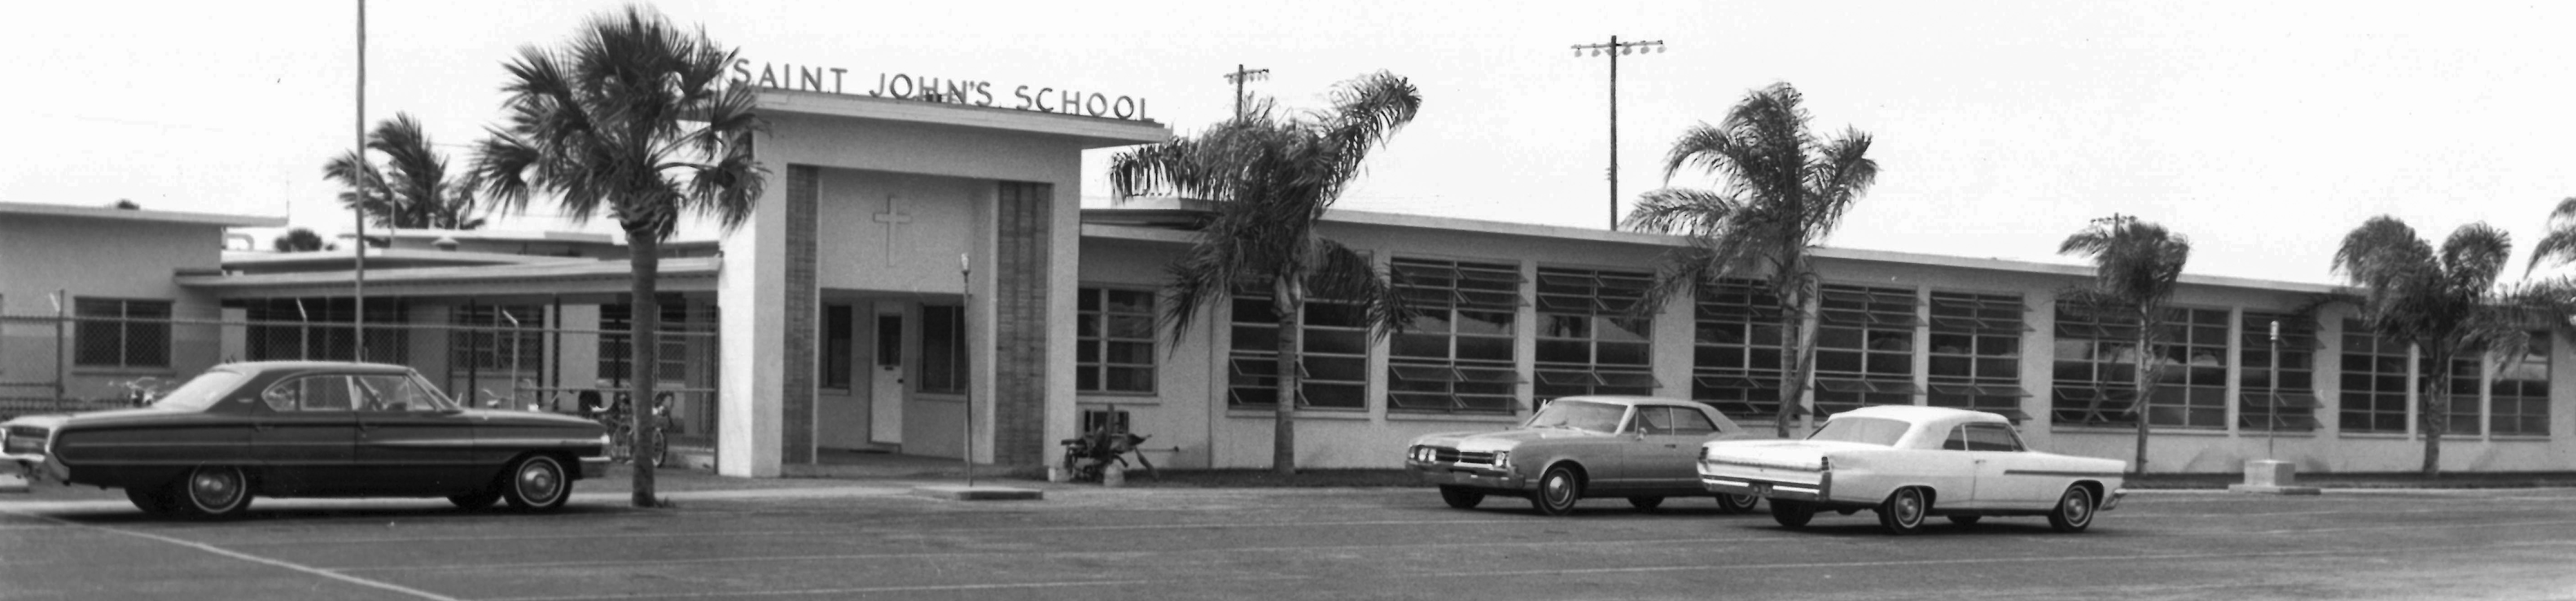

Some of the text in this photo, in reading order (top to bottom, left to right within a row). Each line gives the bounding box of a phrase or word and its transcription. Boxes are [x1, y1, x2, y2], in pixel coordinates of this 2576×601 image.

[733, 58, 1154, 121] SAINT JOHN'S SCHOOL
